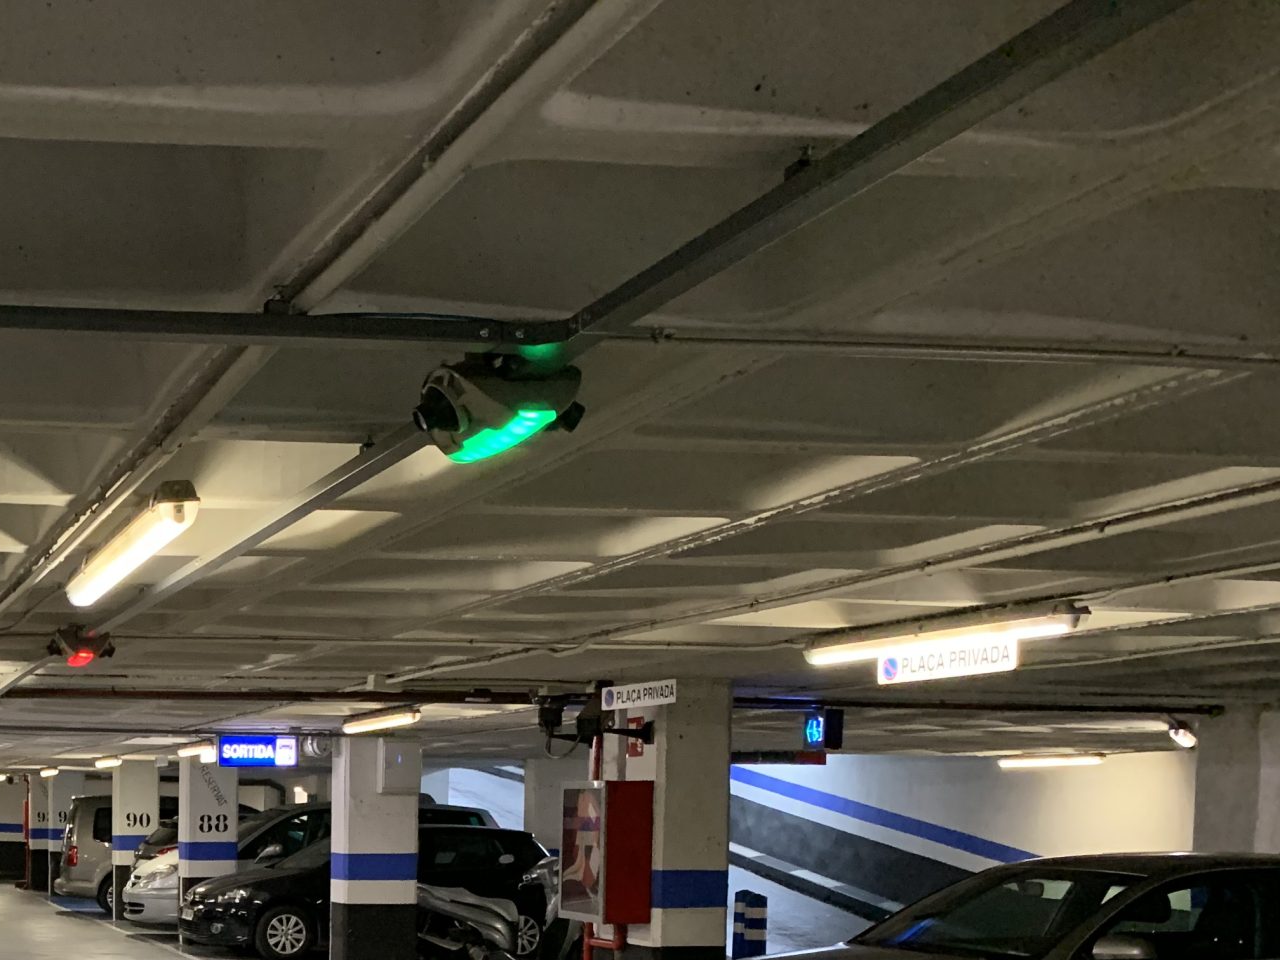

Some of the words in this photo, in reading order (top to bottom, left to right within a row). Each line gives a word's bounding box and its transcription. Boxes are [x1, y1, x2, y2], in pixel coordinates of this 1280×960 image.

[901, 652, 945, 675] PLAÇA
[949, 645, 1010, 668] PRIVADA
[616, 690, 642, 704] PLAÇA
[642, 684, 675, 701] PRIVADA
[222, 743, 275, 759] SORTIDA
[125, 812, 151, 828] 90
[198, 813, 229, 833] 88
